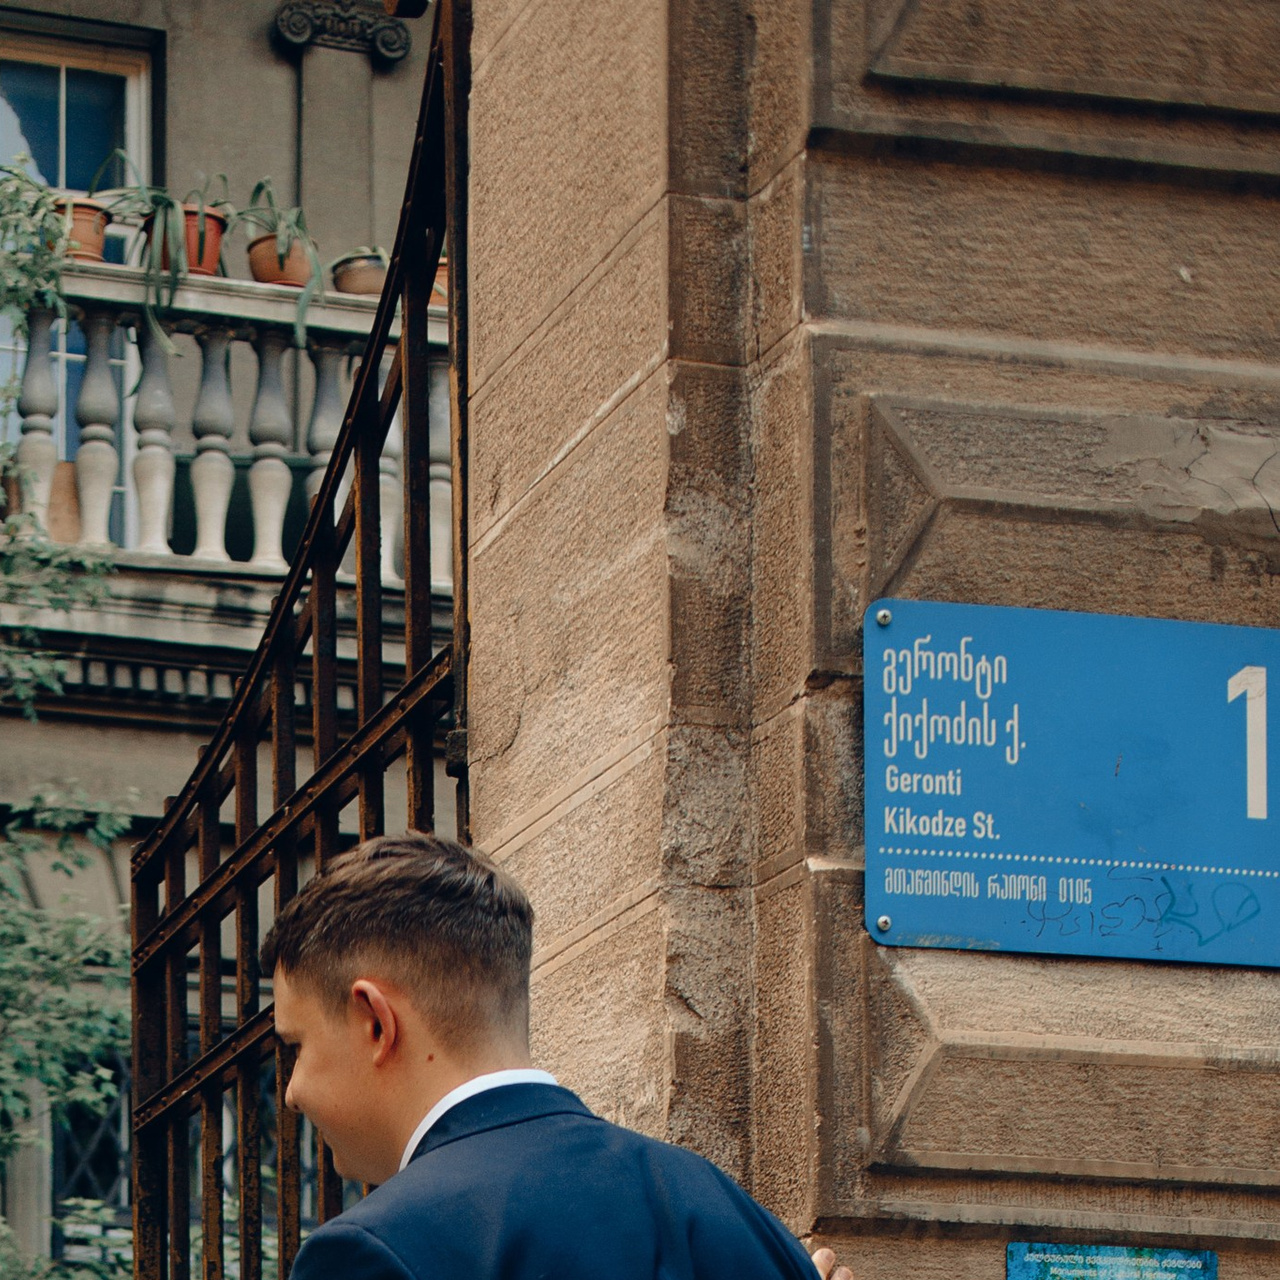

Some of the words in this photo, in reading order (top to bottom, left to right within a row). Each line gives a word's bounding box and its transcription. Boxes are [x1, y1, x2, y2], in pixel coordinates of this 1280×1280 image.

[883, 634, 1007, 699] გერონტი
[883, 696, 997, 758] ქიქოძის
[1005, 703, 1026, 764] ქ.
[1227, 665, 1268, 820] 1
[885, 764, 962, 796] Geronti
[884, 806, 967, 838] Kikodze
[972, 811, 1001, 840] St.
[1059, 877, 1093, 904] 0105
